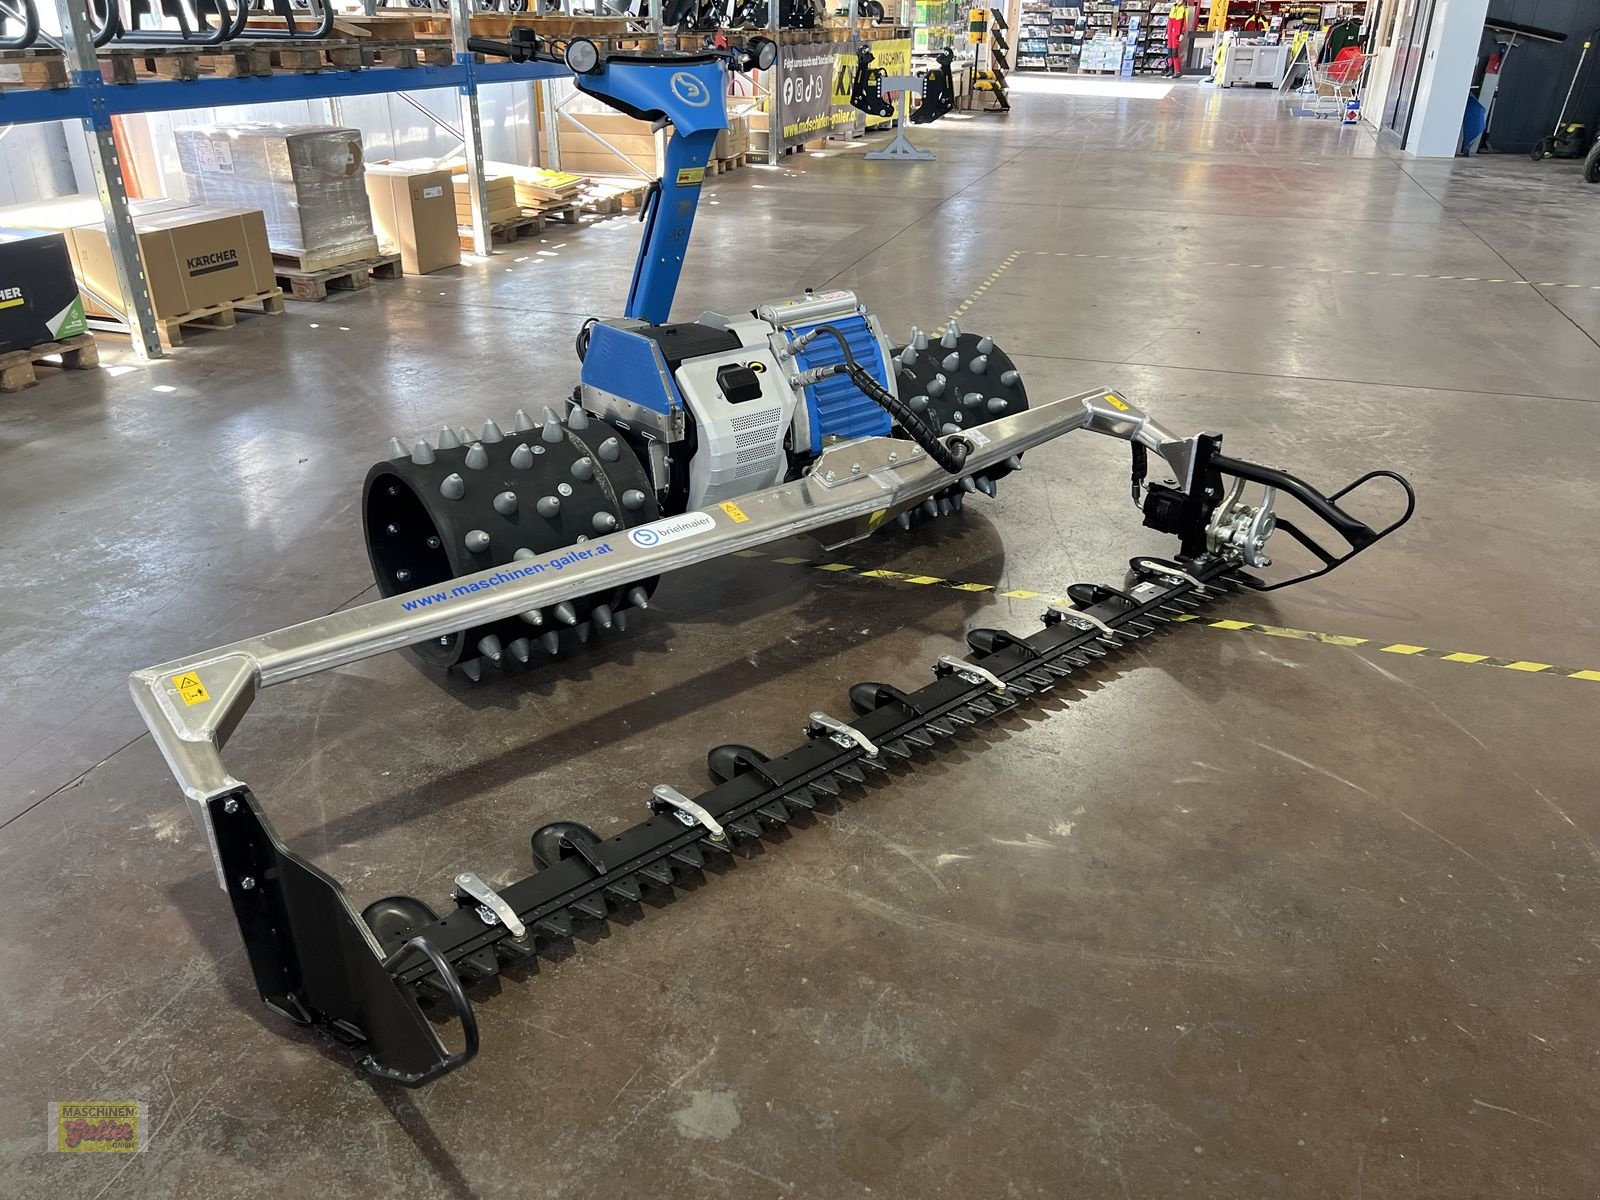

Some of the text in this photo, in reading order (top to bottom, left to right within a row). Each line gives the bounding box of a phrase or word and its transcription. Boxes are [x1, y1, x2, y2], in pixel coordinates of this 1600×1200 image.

[186, 249, 238, 270] KÄRCHER
[658, 517, 710, 537] brielmaier
[401, 542, 614, 612] www.maschinen-gailer.at
